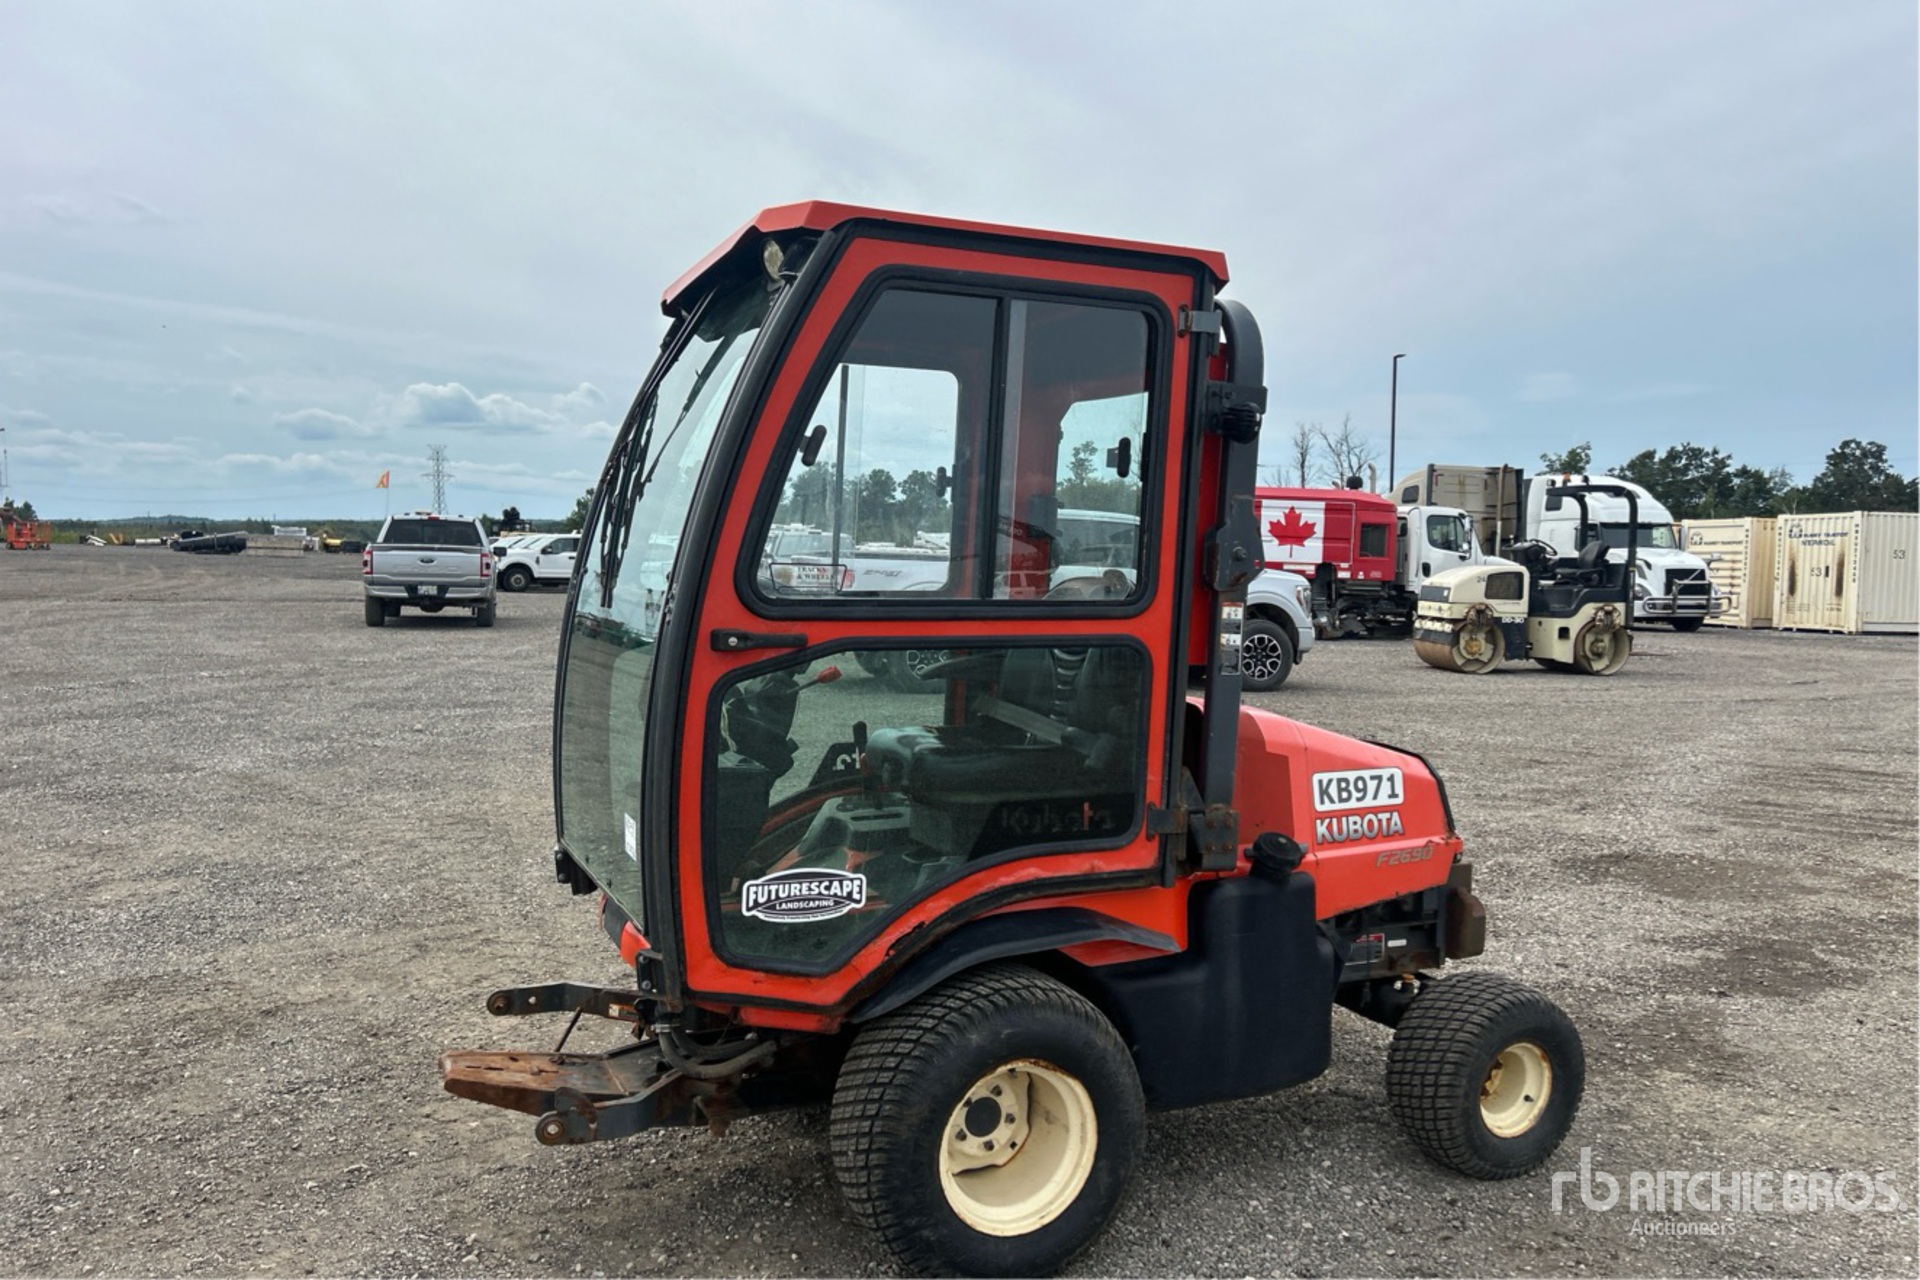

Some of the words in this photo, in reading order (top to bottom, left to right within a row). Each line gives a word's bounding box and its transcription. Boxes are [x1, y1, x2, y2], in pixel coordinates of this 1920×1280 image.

[1893, 549, 1906, 560] 53
[1317, 773, 1400, 806] KB971
[1314, 810, 1405, 844] KUBOTA
[748, 879, 862, 908] FUTURESCAPE
[775, 899, 835, 911] LANDSCAPING
